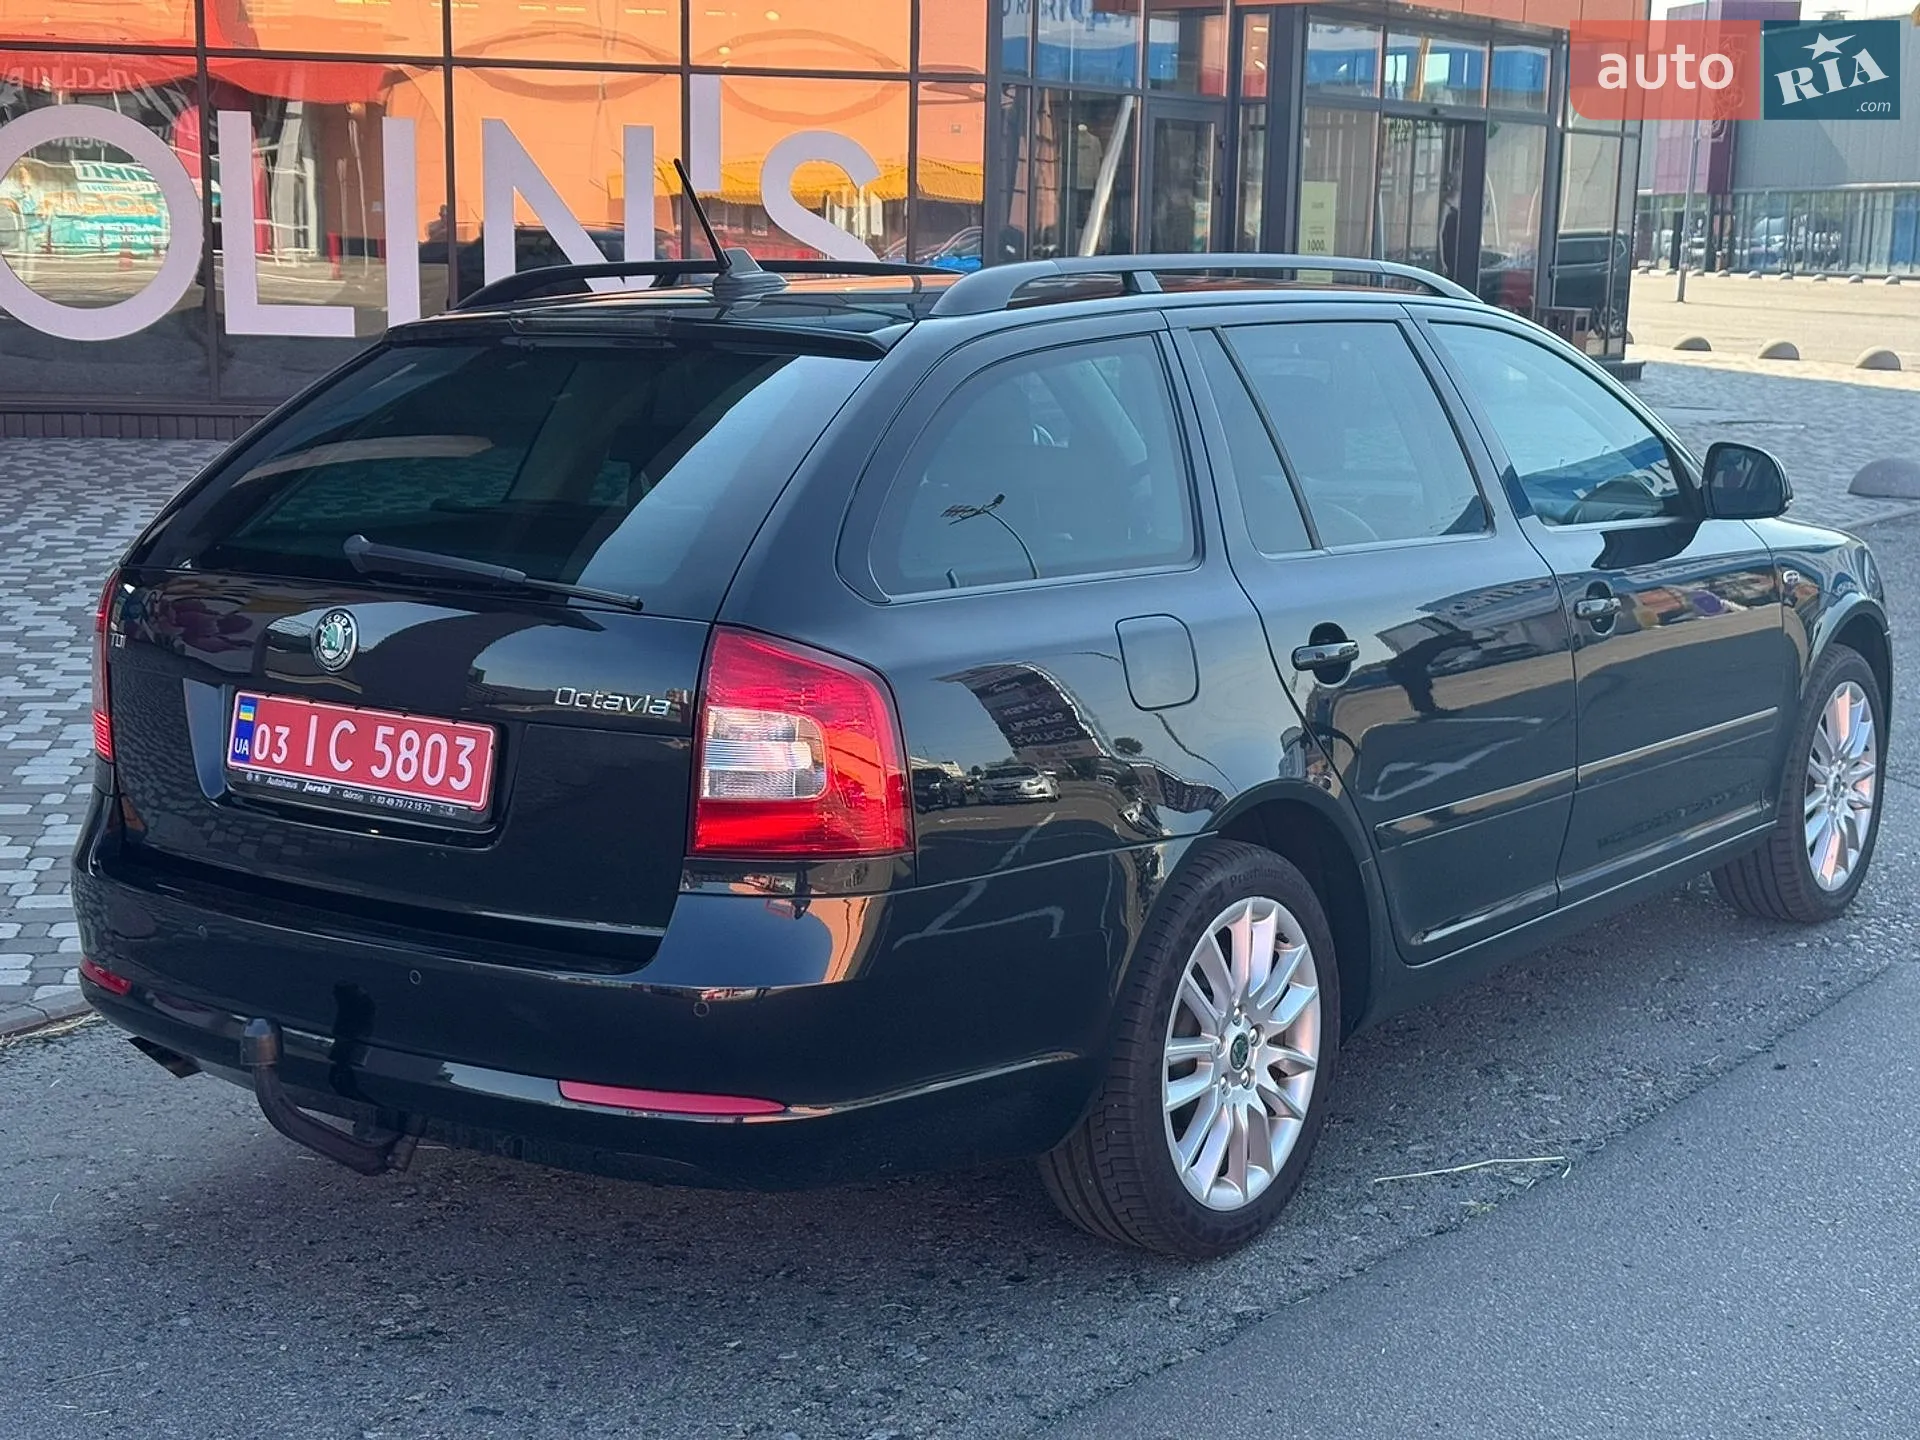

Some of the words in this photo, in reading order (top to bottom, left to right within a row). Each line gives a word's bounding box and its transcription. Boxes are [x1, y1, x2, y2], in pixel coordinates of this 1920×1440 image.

[555, 687, 671, 716] Octavia
[234, 737, 249, 756] UA
[254, 723, 290, 764] 03
[305, 715, 357, 772] IC
[370, 725, 476, 791] 5803
[266, 776, 298, 790] Autohaus
